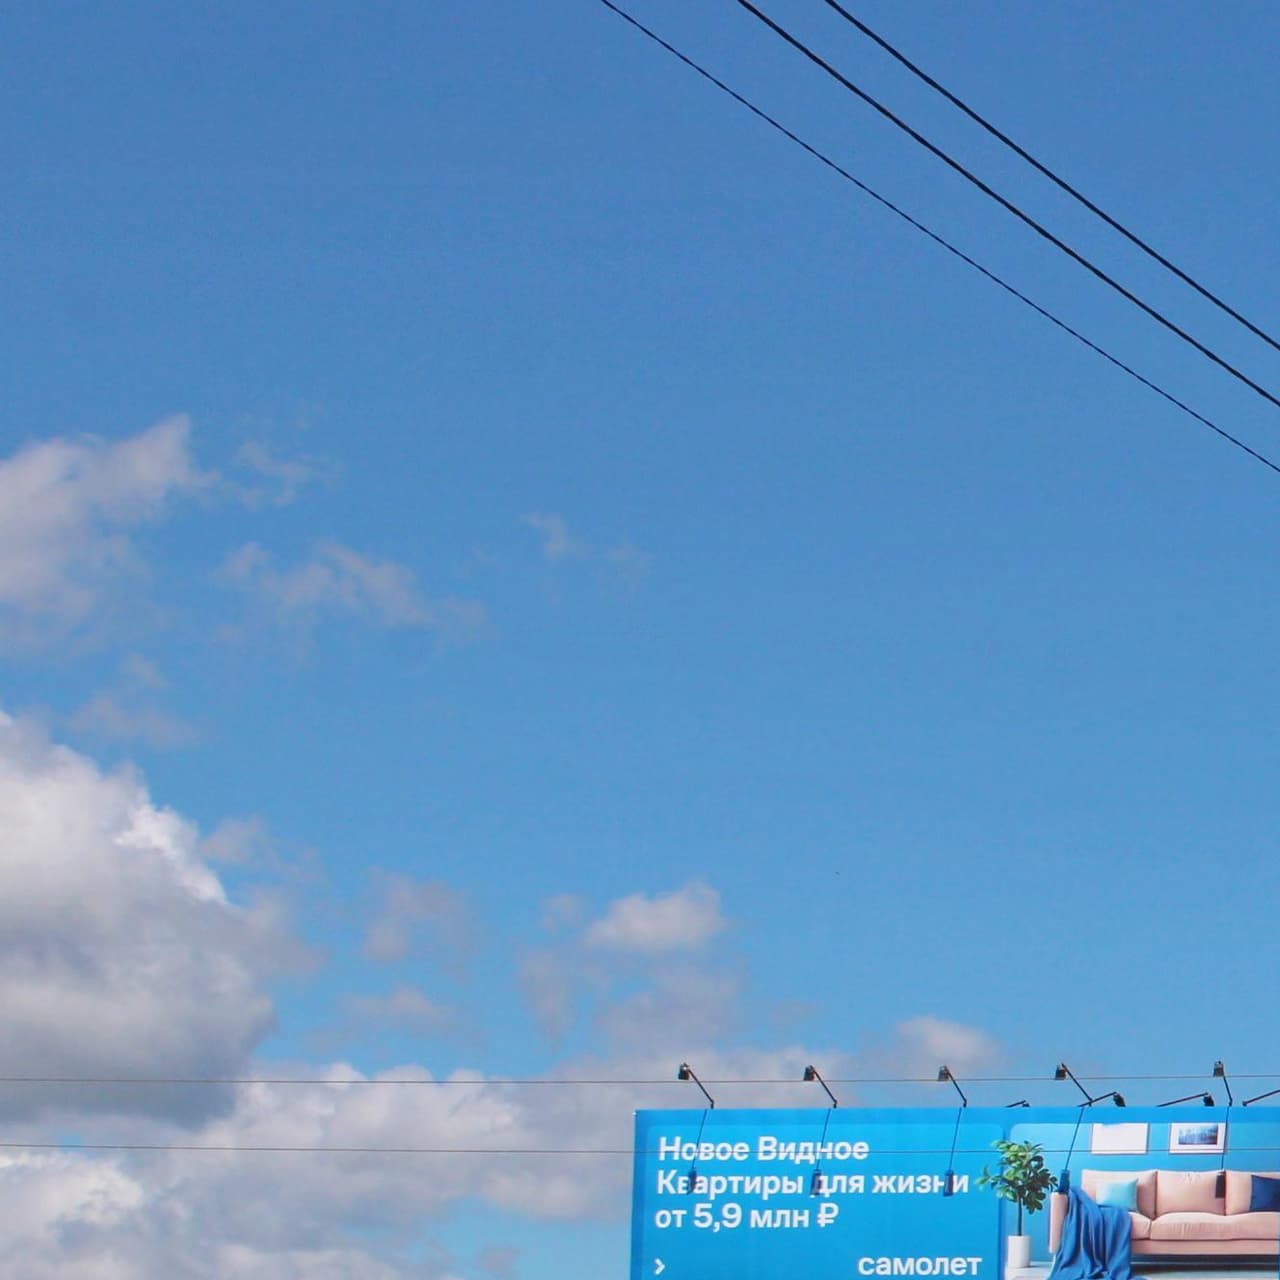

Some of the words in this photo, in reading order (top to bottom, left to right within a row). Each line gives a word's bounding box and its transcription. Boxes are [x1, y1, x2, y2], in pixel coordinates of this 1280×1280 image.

[658, 1135, 750, 1161] Новое
[757, 1135, 870, 1165] Видное
[810, 1173, 865, 1198] для
[654, 1208, 687, 1228] от
[693, 1202, 743, 1233] 5,9
[749, 1208, 810, 1229] млн
[857, 1255, 983, 1277] самолет
